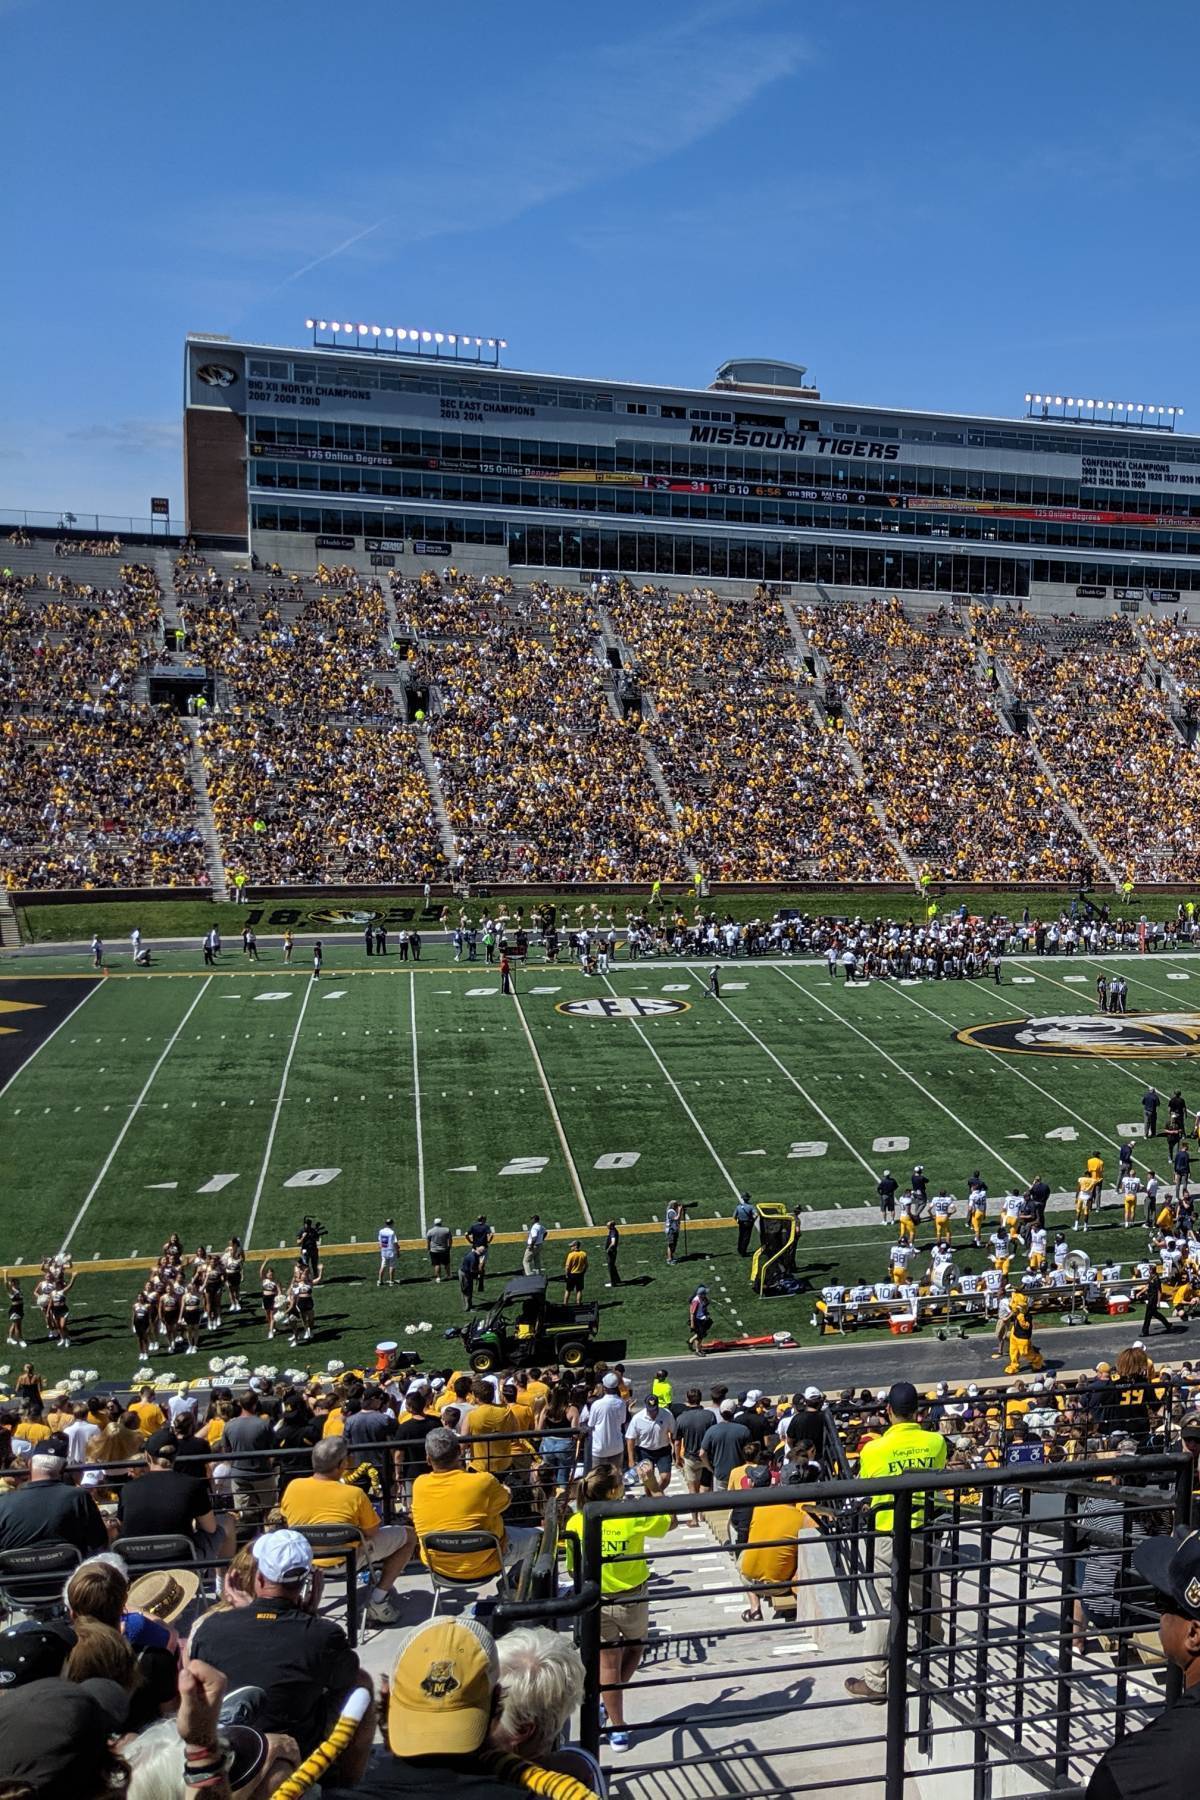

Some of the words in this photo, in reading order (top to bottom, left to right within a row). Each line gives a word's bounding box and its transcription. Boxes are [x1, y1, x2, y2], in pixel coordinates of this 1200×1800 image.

[248, 380, 263, 390] BIG
[266, 382, 278, 392] XII
[281, 383, 312, 395] NORTH
[315, 387, 371, 400] CHAMPIONS
[248, 391, 270, 401] 2007
[275, 394, 296, 404] 2008
[300, 396, 320, 406] 2010
[440, 399, 456, 409] SEC
[459, 401, 481, 411] EAST
[483, 402, 535, 417] CHAMPIONS
[440, 410, 460, 420] 2013
[464, 412, 483, 422] 2014
[689, 425, 806, 451] MISSOURI
[816, 437, 900, 460] TIGERS
[307, 450, 322, 459] 125
[325, 452, 353, 462] Online
[355, 454, 393, 465] Degrees
[479, 464, 494, 473] 125
[496, 467, 524, 476] Online
[1081, 458, 1126, 469] CONFERENCE
[1128, 462, 1170, 473] CHAMPIONS
[1164, 474, 1178, 483] 1927
[691, 481, 705, 491] 31
[800, 490, 817, 500] 3RD
[825, 1291, 841, 1303] 84
[879, 1287, 891, 1299] 10
[1118, 1304, 1125, 1313] G
[900, 1324, 909, 1333] G
[892, 1447, 930, 1457] Keystone
[888, 1456, 936, 1473] EVENT
[434, 1682, 446, 1692] M
